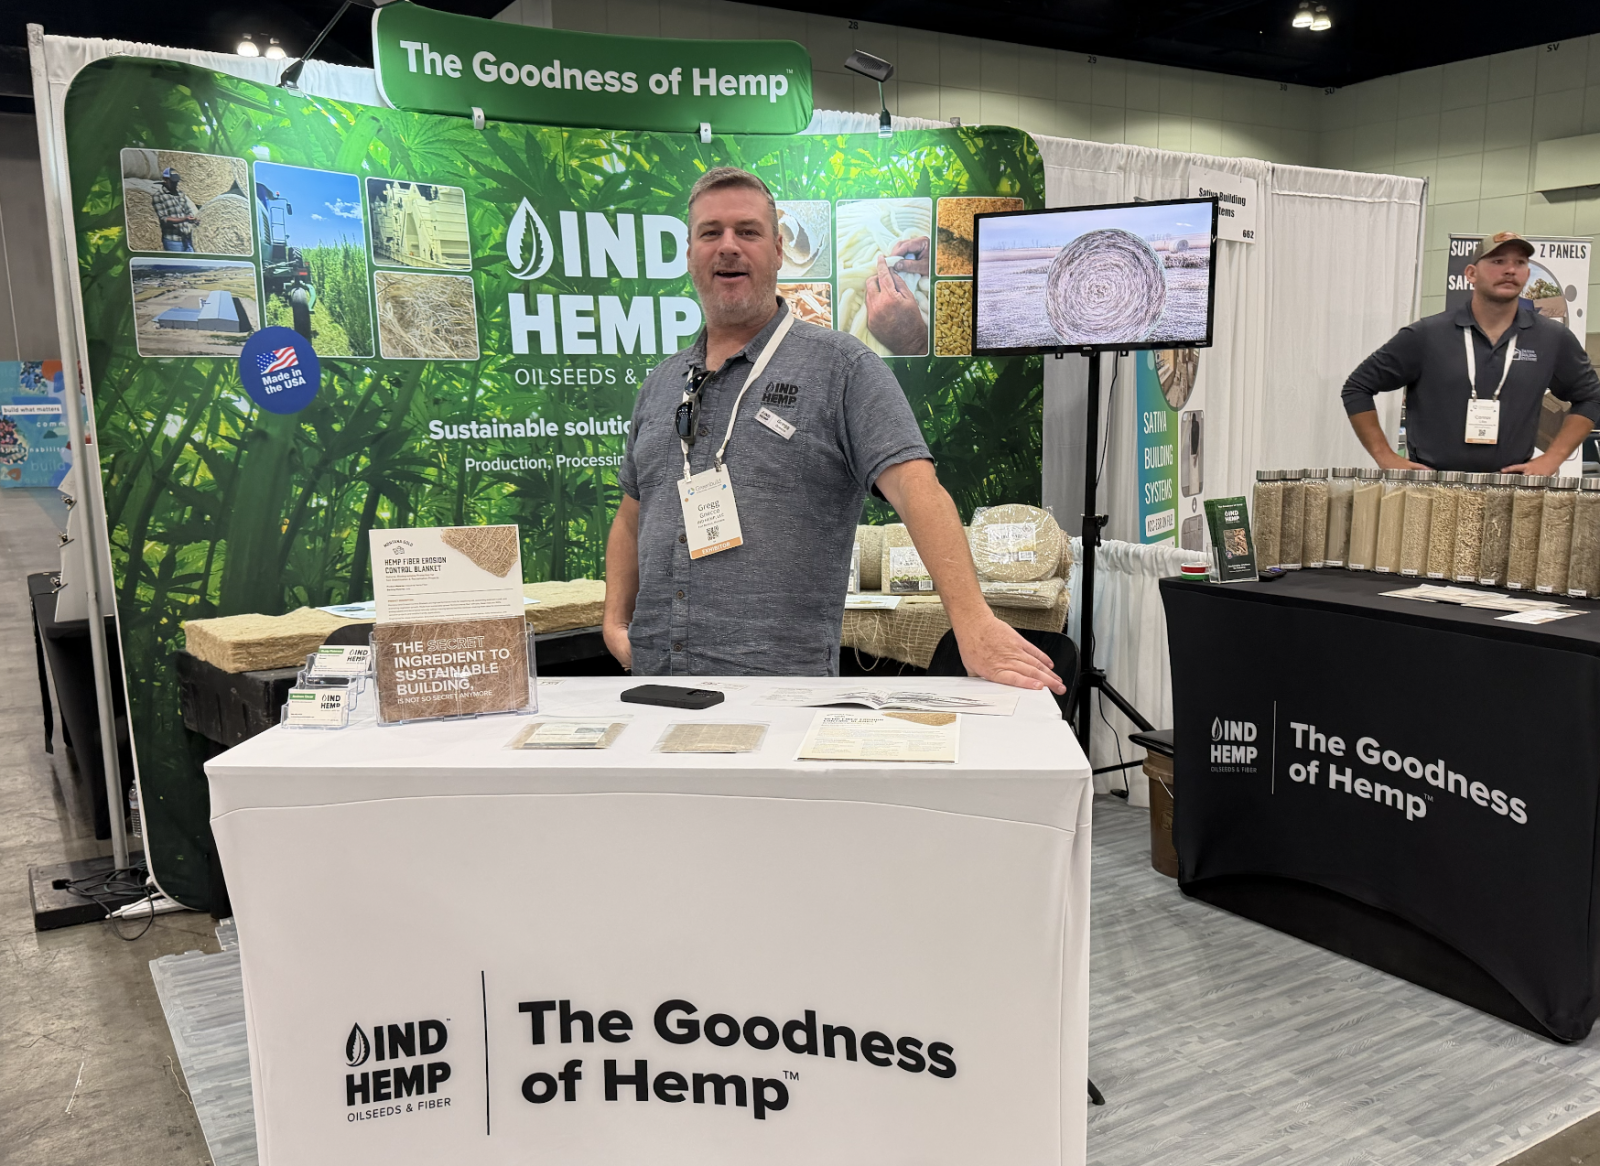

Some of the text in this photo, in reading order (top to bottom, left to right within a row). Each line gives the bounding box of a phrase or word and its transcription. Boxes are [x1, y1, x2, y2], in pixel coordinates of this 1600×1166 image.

[848, 20, 858, 30] 28
[1547, 43, 1559, 52] SV
[400, 40, 462, 78] The
[473, 50, 639, 94] Goodness
[649, 68, 682, 95] of
[693, 68, 788, 102] Hemp
[1220, 192, 1246, 206] Building
[1218, 207, 1234, 217] tems
[1243, 230, 1254, 239] 662
[559, 210, 688, 280] IND
[1451, 241, 1480, 256] SUPE
[1540, 244, 1586, 259] Z PANELS
[508, 293, 702, 355] HEMP
[262, 368, 302, 385] Made in
[265, 376, 306, 394] the USA
[514, 368, 617, 385] OILSEEDS
[625, 369, 637, 384] &
[762, 393, 797, 404] HEMP
[775, 383, 799, 395] IND
[428, 415, 631, 440] Sustainable solutio
[1144, 411, 1167, 434] SATIVA
[465, 458, 552, 472] Production,
[1144, 444, 1173, 470] BUILDING
[1145, 478, 1172, 504] SYSTEMS
[698, 500, 720, 512] Gregg
[702, 542, 730, 554] EXHIBITOR
[392, 636, 485, 654] THE SECRET
[394, 648, 510, 668] INGREDIENT TO
[395, 662, 498, 682] SUSTAINABLE
[397, 678, 474, 696] BUILDING,
[459, 690, 493, 698] ANYMORE
[1224, 720, 1257, 742] IND
[1211, 744, 1258, 764] HEMP
[1290, 722, 1528, 824] The Goodness
[1289, 760, 1320, 784] of
[1329, 764, 1426, 822] Hemp
[374, 1020, 448, 1062] IND
[518, 1000, 956, 1078] The Goodness
[346, 1062, 451, 1106] HEMP
[522, 1060, 582, 1104] of
[604, 1060, 790, 1120] Hemp
[347, 1098, 451, 1122] OILSEEDS & FIBER
